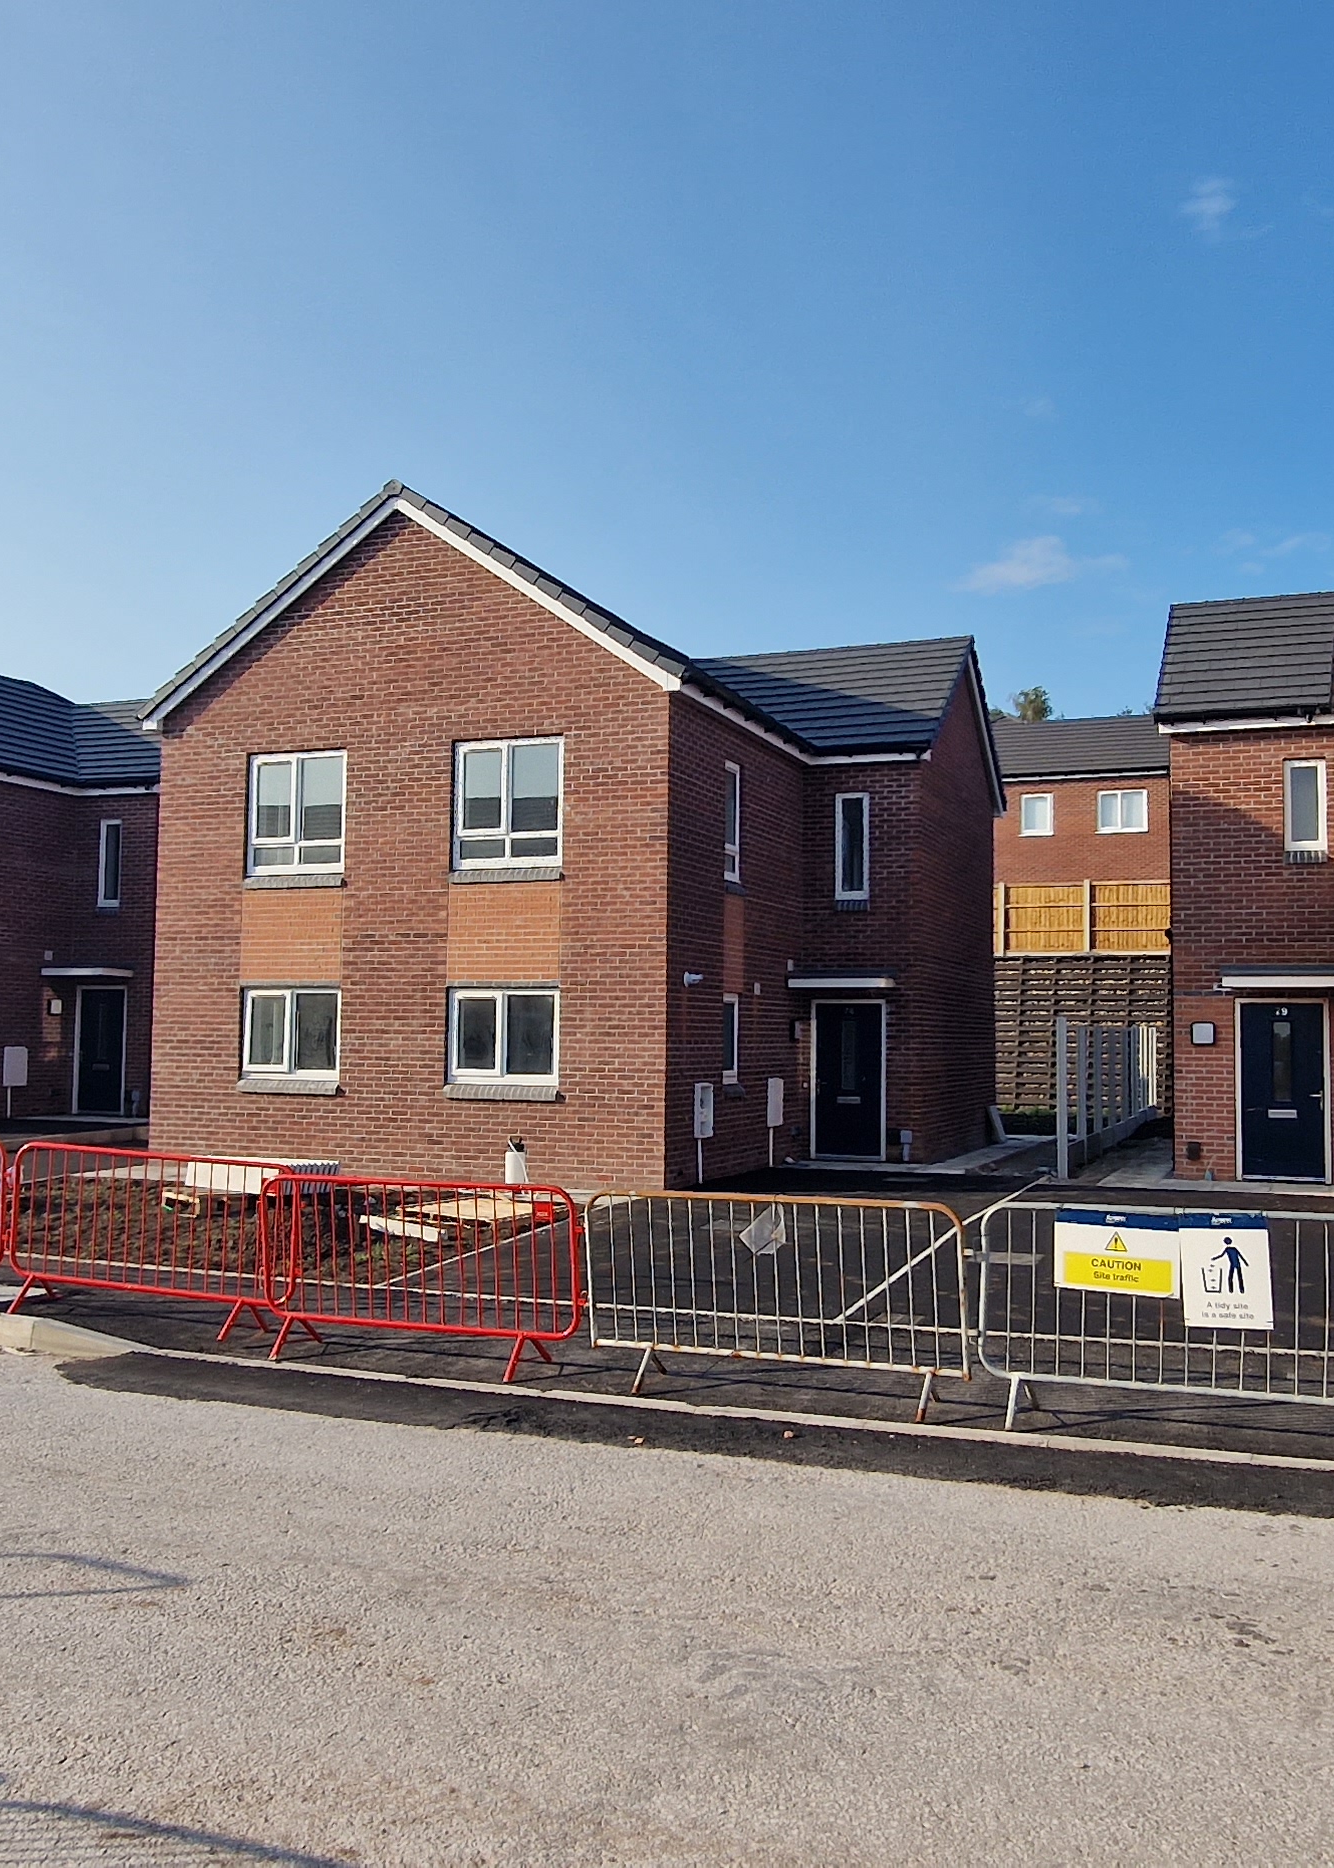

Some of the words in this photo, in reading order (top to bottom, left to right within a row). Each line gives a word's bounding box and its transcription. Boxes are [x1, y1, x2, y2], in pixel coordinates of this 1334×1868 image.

[1091, 1258, 1142, 1271] CAUTION
[1093, 1270, 1111, 1280] Site
[1112, 1273, 1140, 1283] traffic
[1206, 1301, 1213, 1309] A
[1214, 1302, 1231, 1311] tidy
[1218, 1311, 1237, 1319] safe
